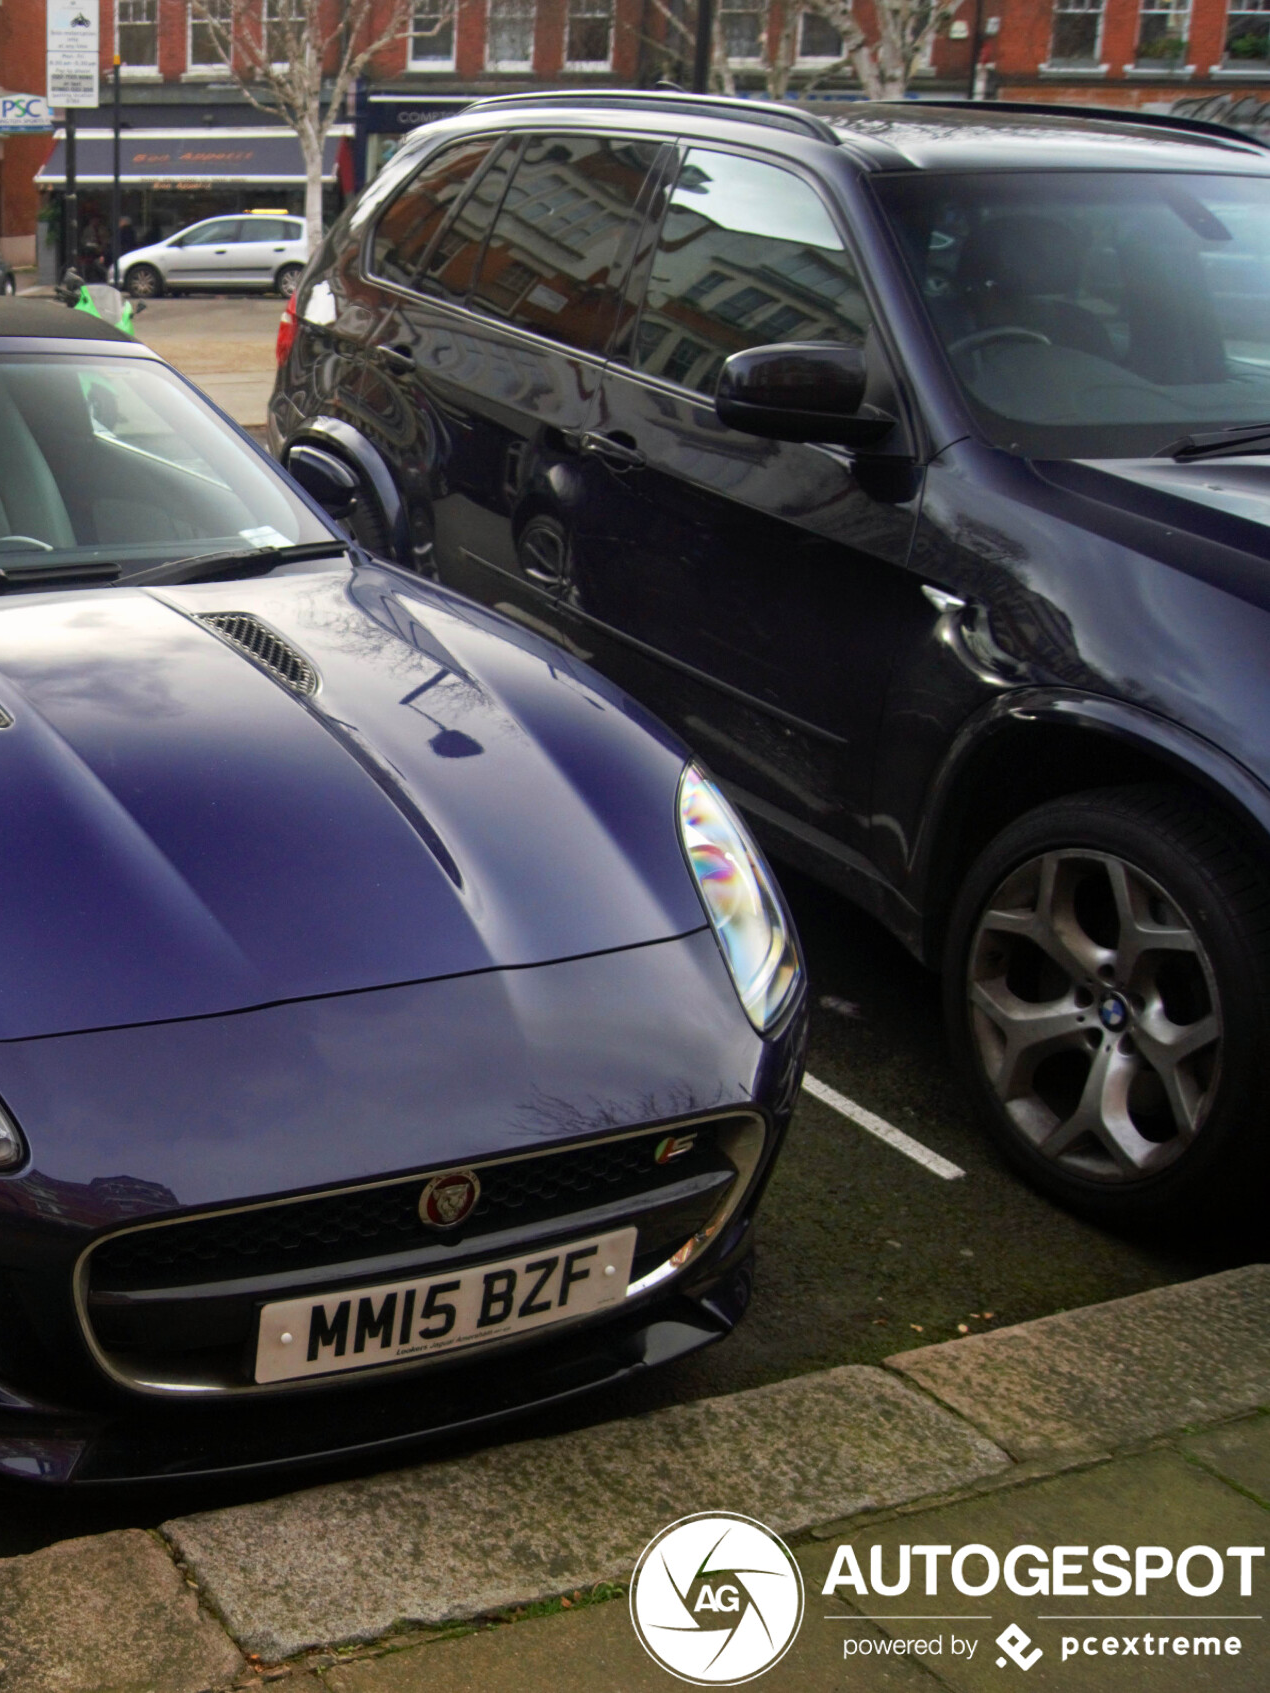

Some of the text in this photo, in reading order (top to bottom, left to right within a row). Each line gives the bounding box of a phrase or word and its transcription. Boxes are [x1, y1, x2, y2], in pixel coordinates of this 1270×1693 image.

[1, 99, 41, 117] PSC
[306, 1244, 599, 1362] MM15 BZF
